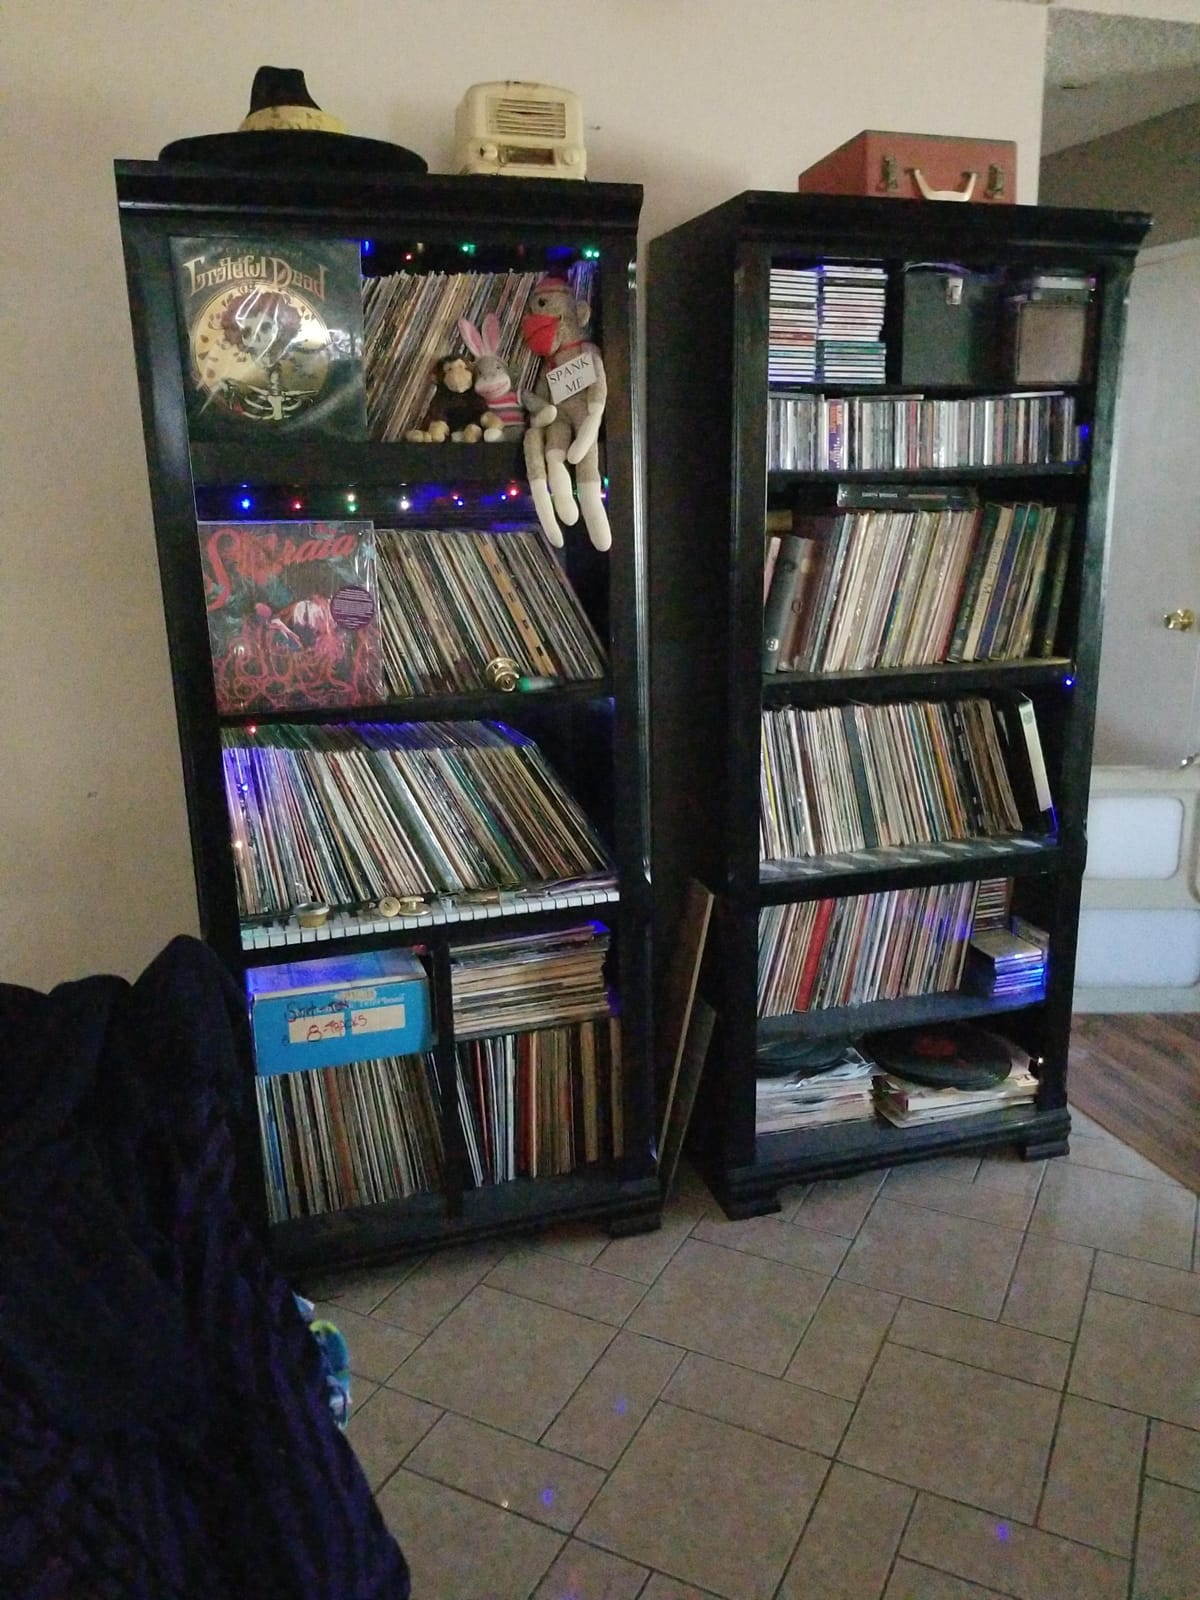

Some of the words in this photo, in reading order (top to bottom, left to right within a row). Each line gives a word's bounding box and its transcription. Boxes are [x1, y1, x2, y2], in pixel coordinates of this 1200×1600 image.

[269, 256, 329, 301] Dead
[548, 358, 589, 382] SPANK
[565, 377, 583, 393] ME
